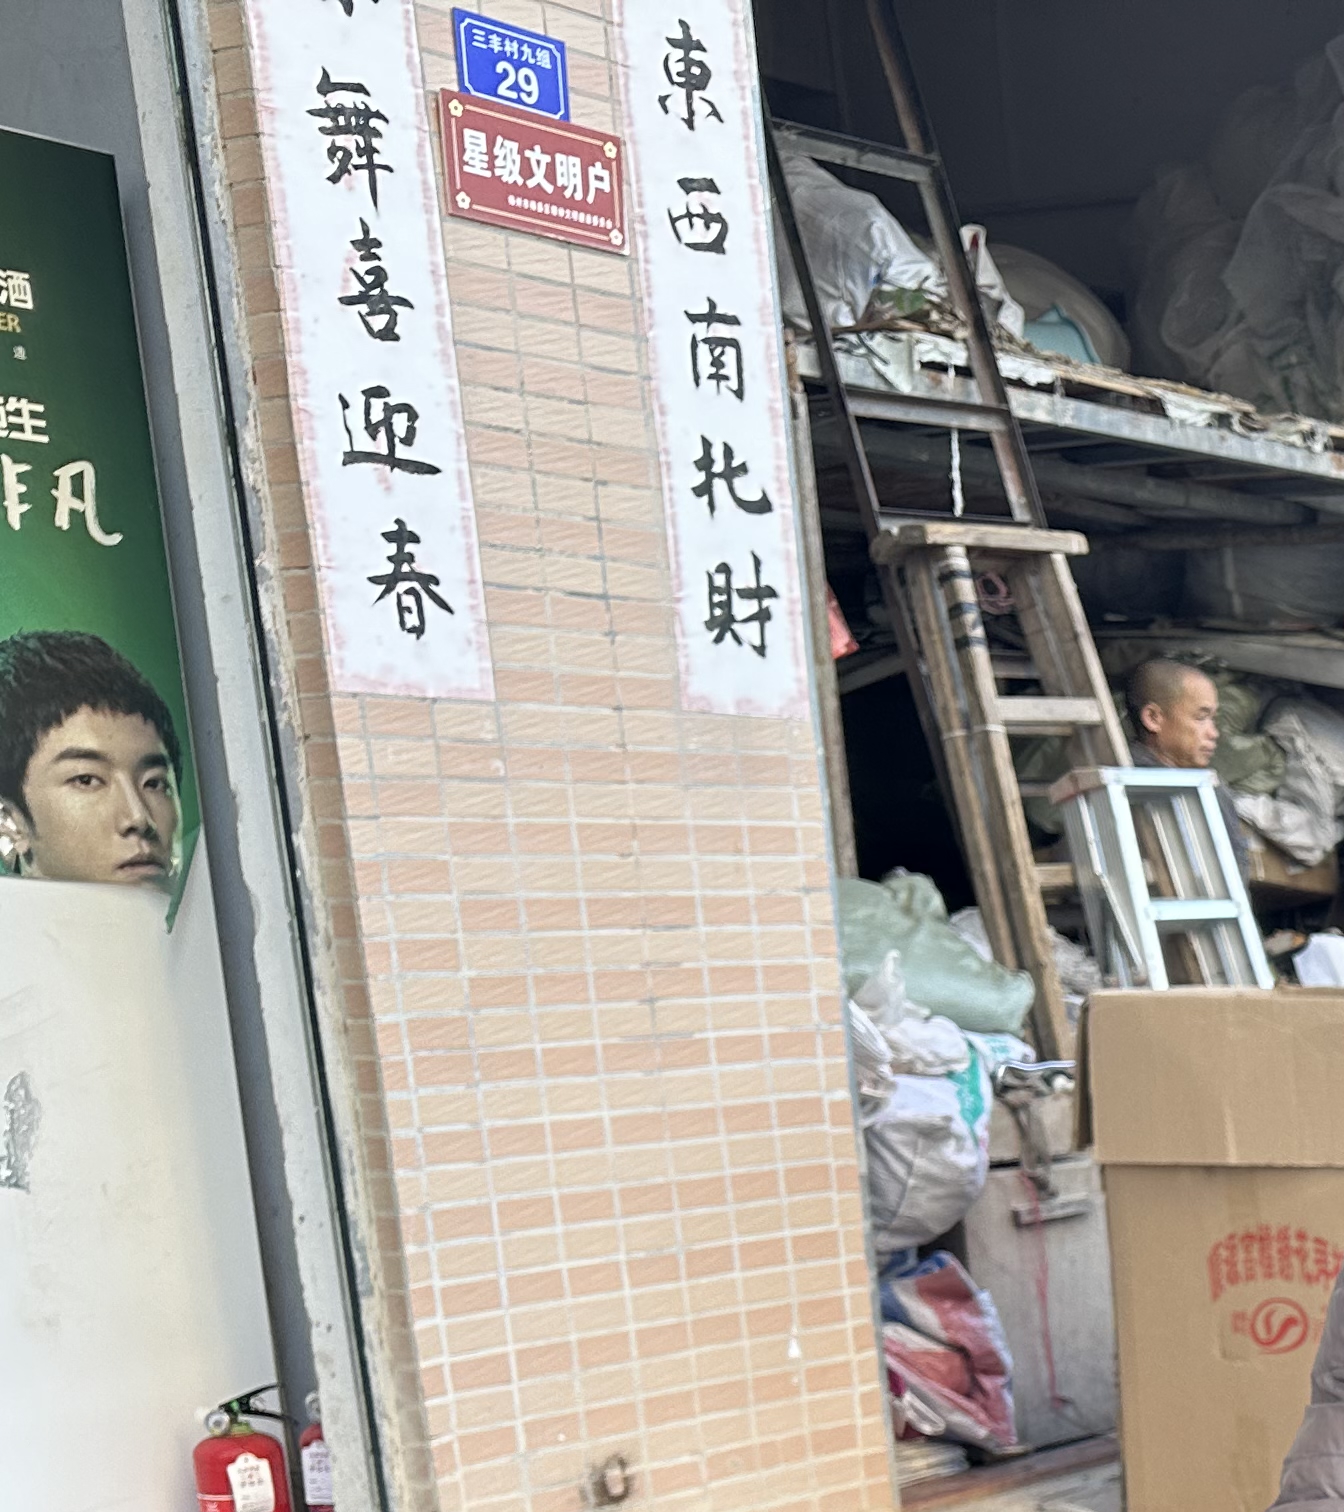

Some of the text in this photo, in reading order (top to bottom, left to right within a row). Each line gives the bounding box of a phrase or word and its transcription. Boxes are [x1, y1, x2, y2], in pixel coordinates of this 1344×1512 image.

[495, 60, 540, 105] 29
[462, 127, 612, 205] 星级文明户
[305, 0, 454, 640] 舞喜迎春
[0, 395, 50, 444] 生
